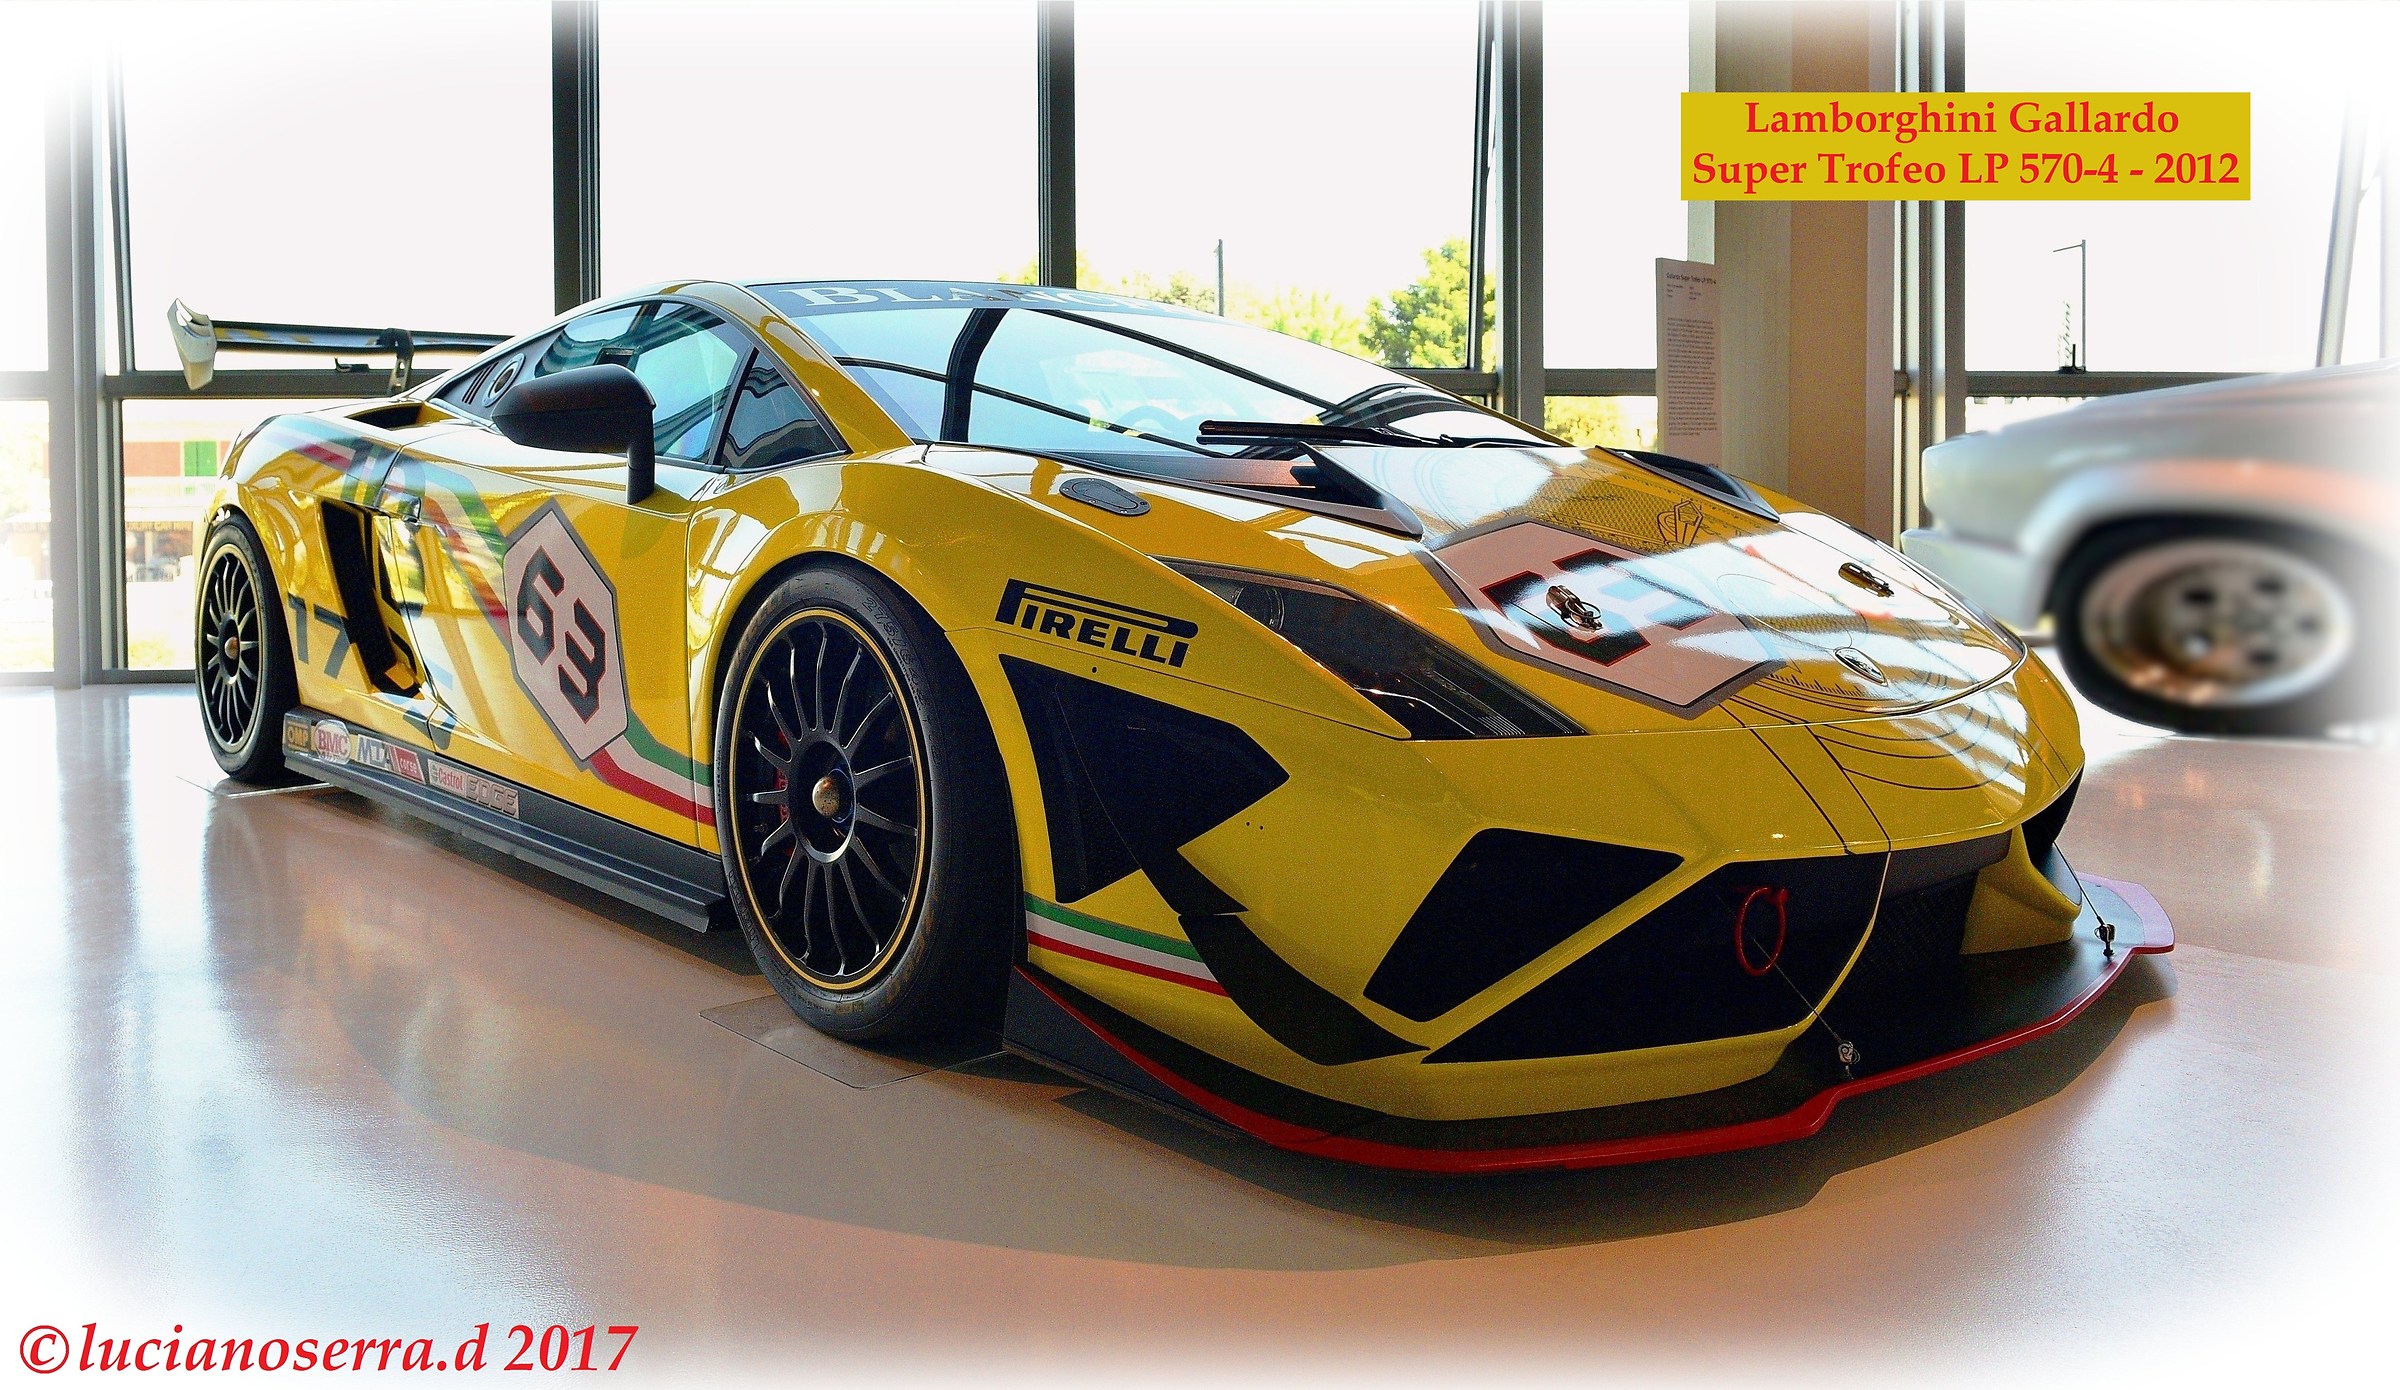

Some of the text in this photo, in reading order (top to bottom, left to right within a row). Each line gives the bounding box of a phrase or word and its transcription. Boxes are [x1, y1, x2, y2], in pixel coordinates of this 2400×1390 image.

[778, 286, 1155, 311] BLANC
[516, 544, 606, 725] 63
[994, 578, 1199, 669] PIRELLI
[287, 726, 309, 748] OMP
[318, 729, 349, 755] BMC
[438, 767, 464, 791] Castrol
[466, 774, 518, 816] EDGE
